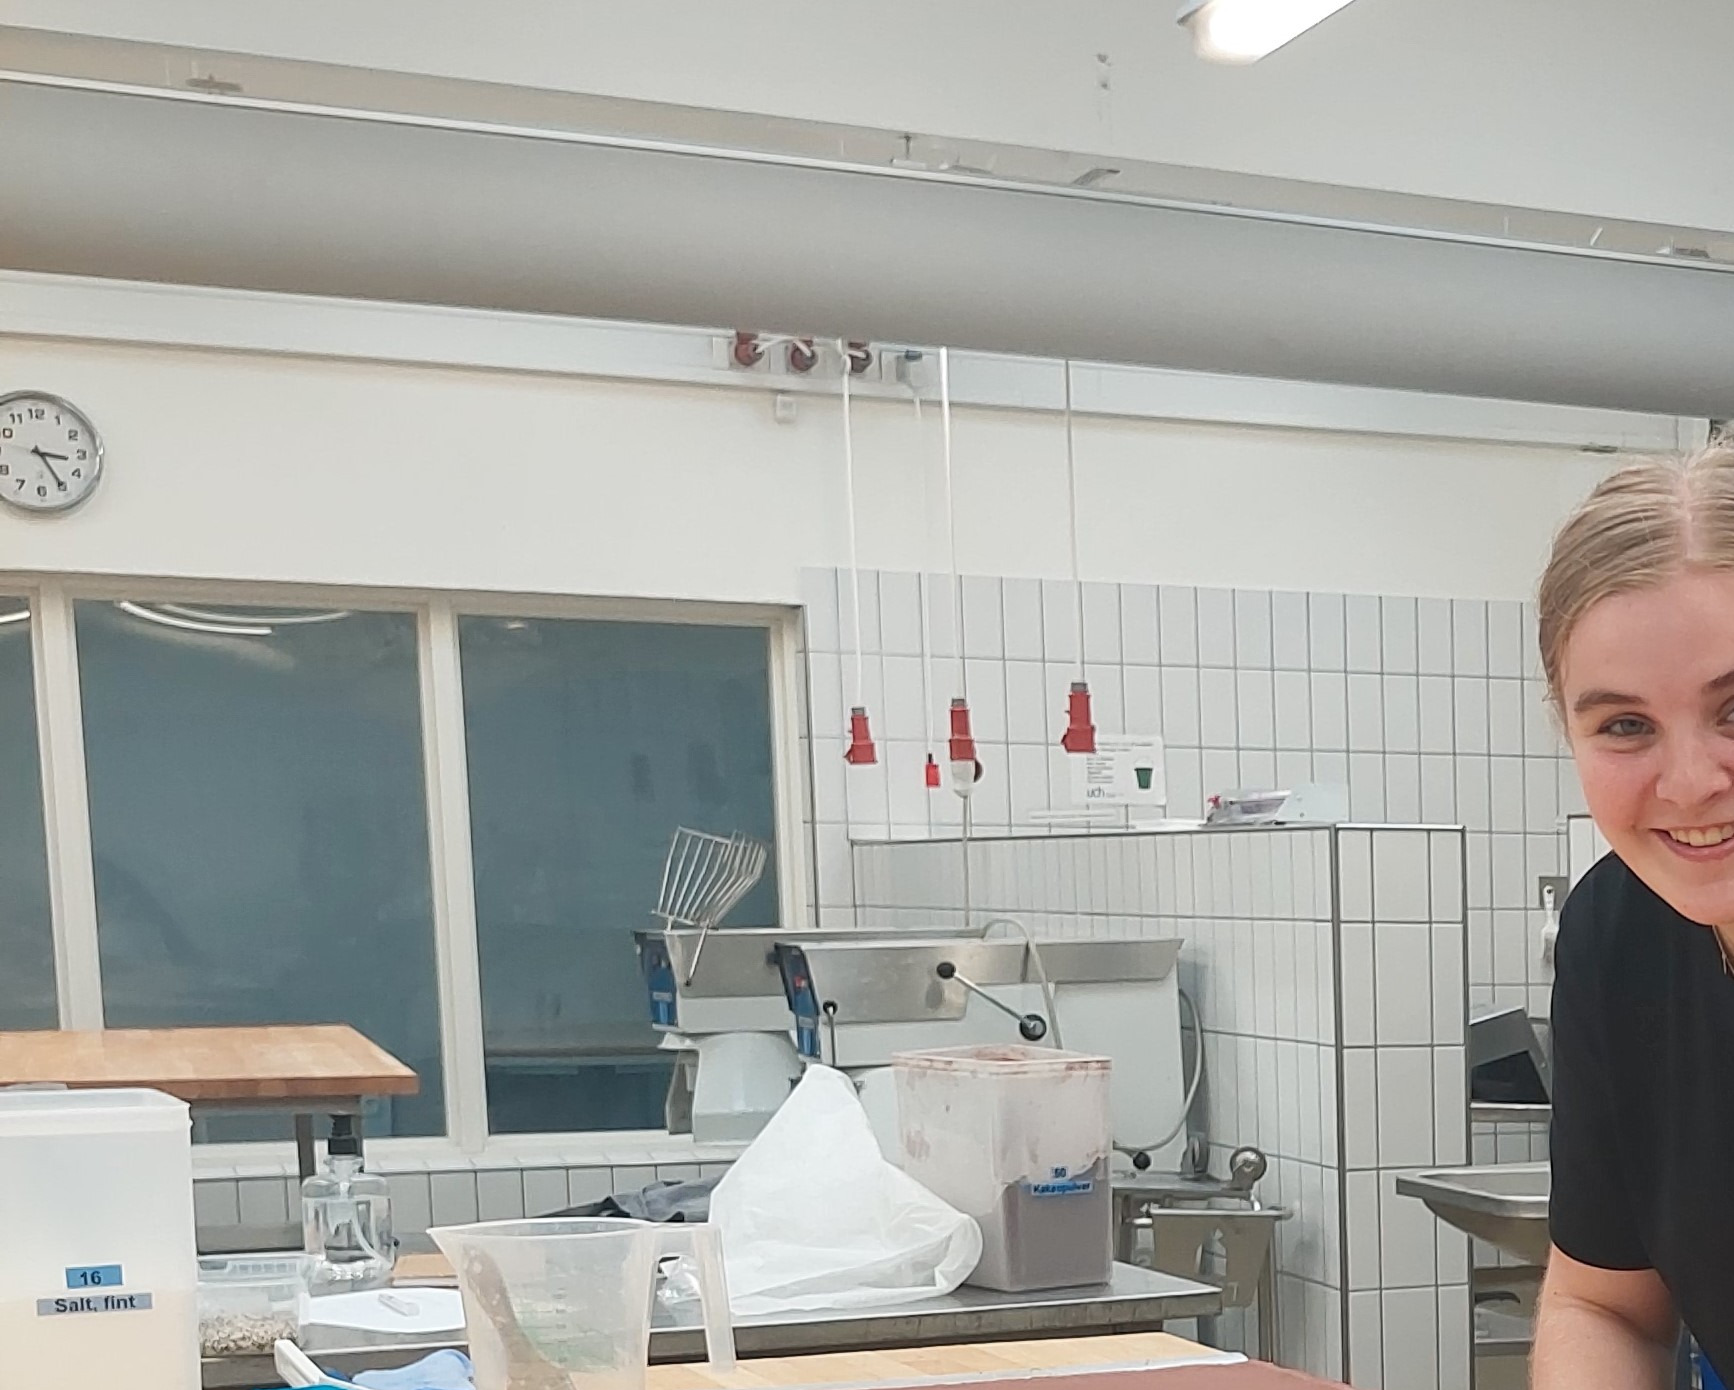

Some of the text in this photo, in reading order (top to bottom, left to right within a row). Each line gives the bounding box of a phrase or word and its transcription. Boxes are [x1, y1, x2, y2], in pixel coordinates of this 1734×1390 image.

[9, 412, 23, 424] 11
[28, 408, 45, 420] 12
[55, 414, 61, 425] 1
[68, 428, 79, 441] 2
[77, 448, 87, 460] 3
[71, 467, 82, 479] 4
[15, 478, 26, 490] 7
[37, 485, 47, 497] 6
[80, 1270, 102, 1286] 16
[54, 1294, 136, 1313] Salt, fint
